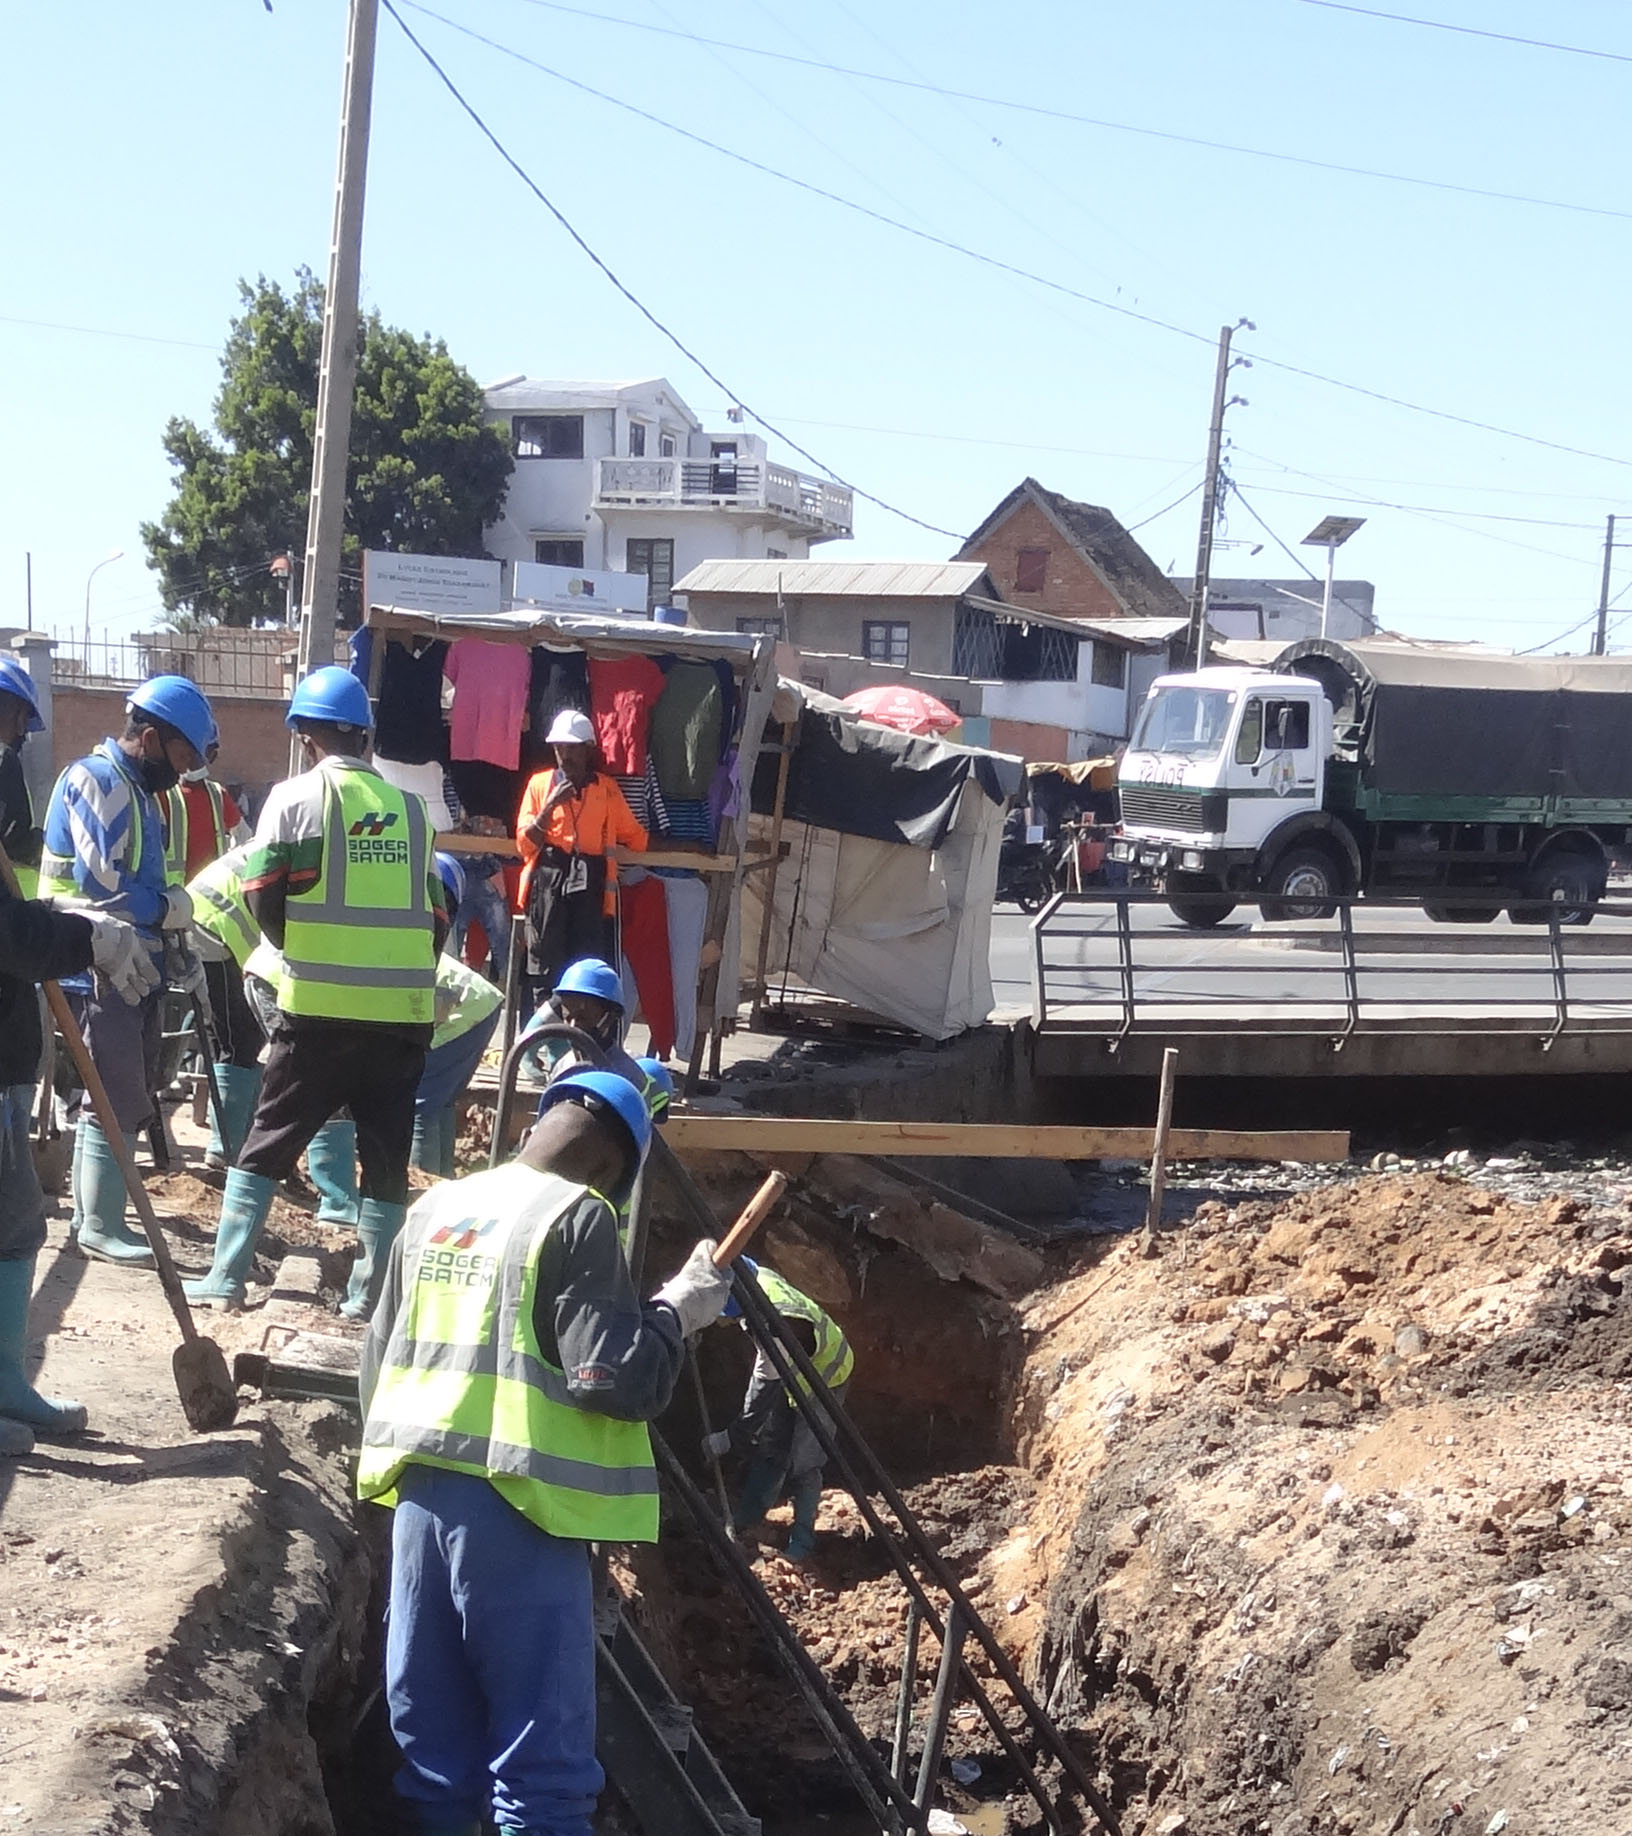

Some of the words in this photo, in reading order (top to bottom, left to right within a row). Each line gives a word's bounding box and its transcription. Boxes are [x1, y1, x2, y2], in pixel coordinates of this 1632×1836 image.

[348, 839, 408, 851] SOGEA
[349, 851, 408, 865] SATOM
[421, 1248, 497, 1270] SOGEA
